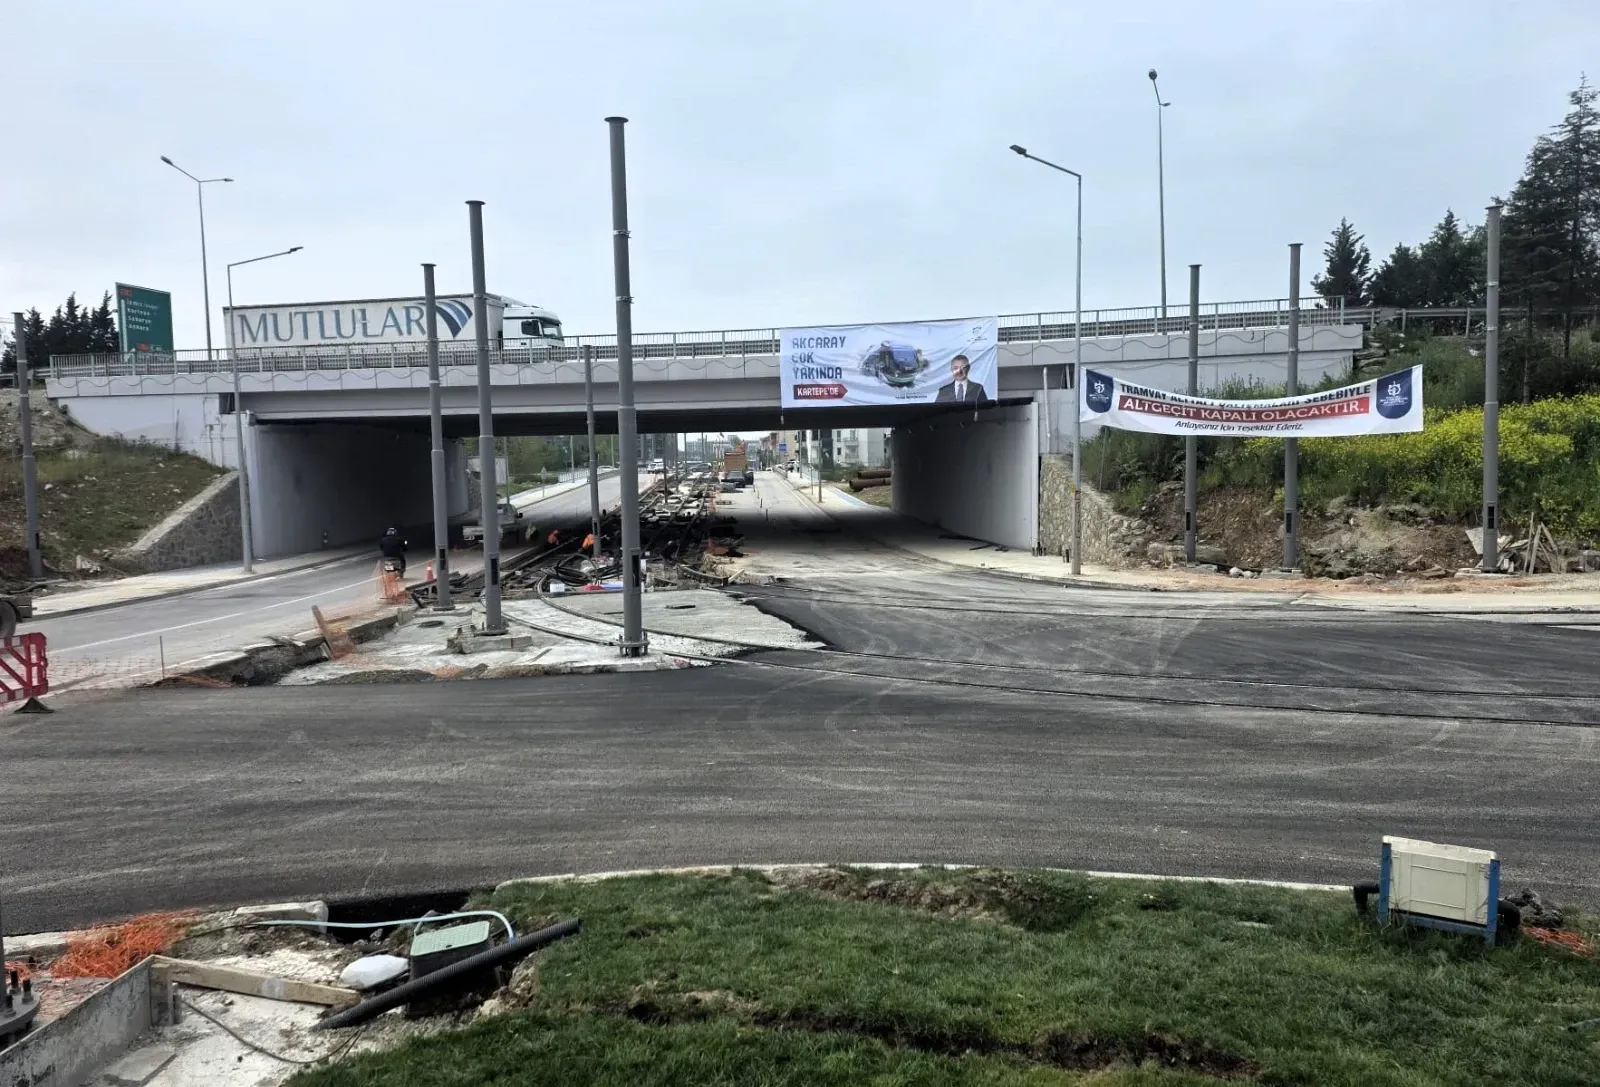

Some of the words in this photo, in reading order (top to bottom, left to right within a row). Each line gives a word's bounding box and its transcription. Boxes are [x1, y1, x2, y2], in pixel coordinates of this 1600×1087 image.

[238, 305, 427, 344] MUTLULAR
[792, 336, 846, 349] AKCARAY
[793, 366, 843, 380] YAKINDA
[797, 387, 840, 397] KARTEPE'DE
[1200, 409, 1256, 421] KAPALI
[1261, 400, 1364, 421] OLACAKTIR.
